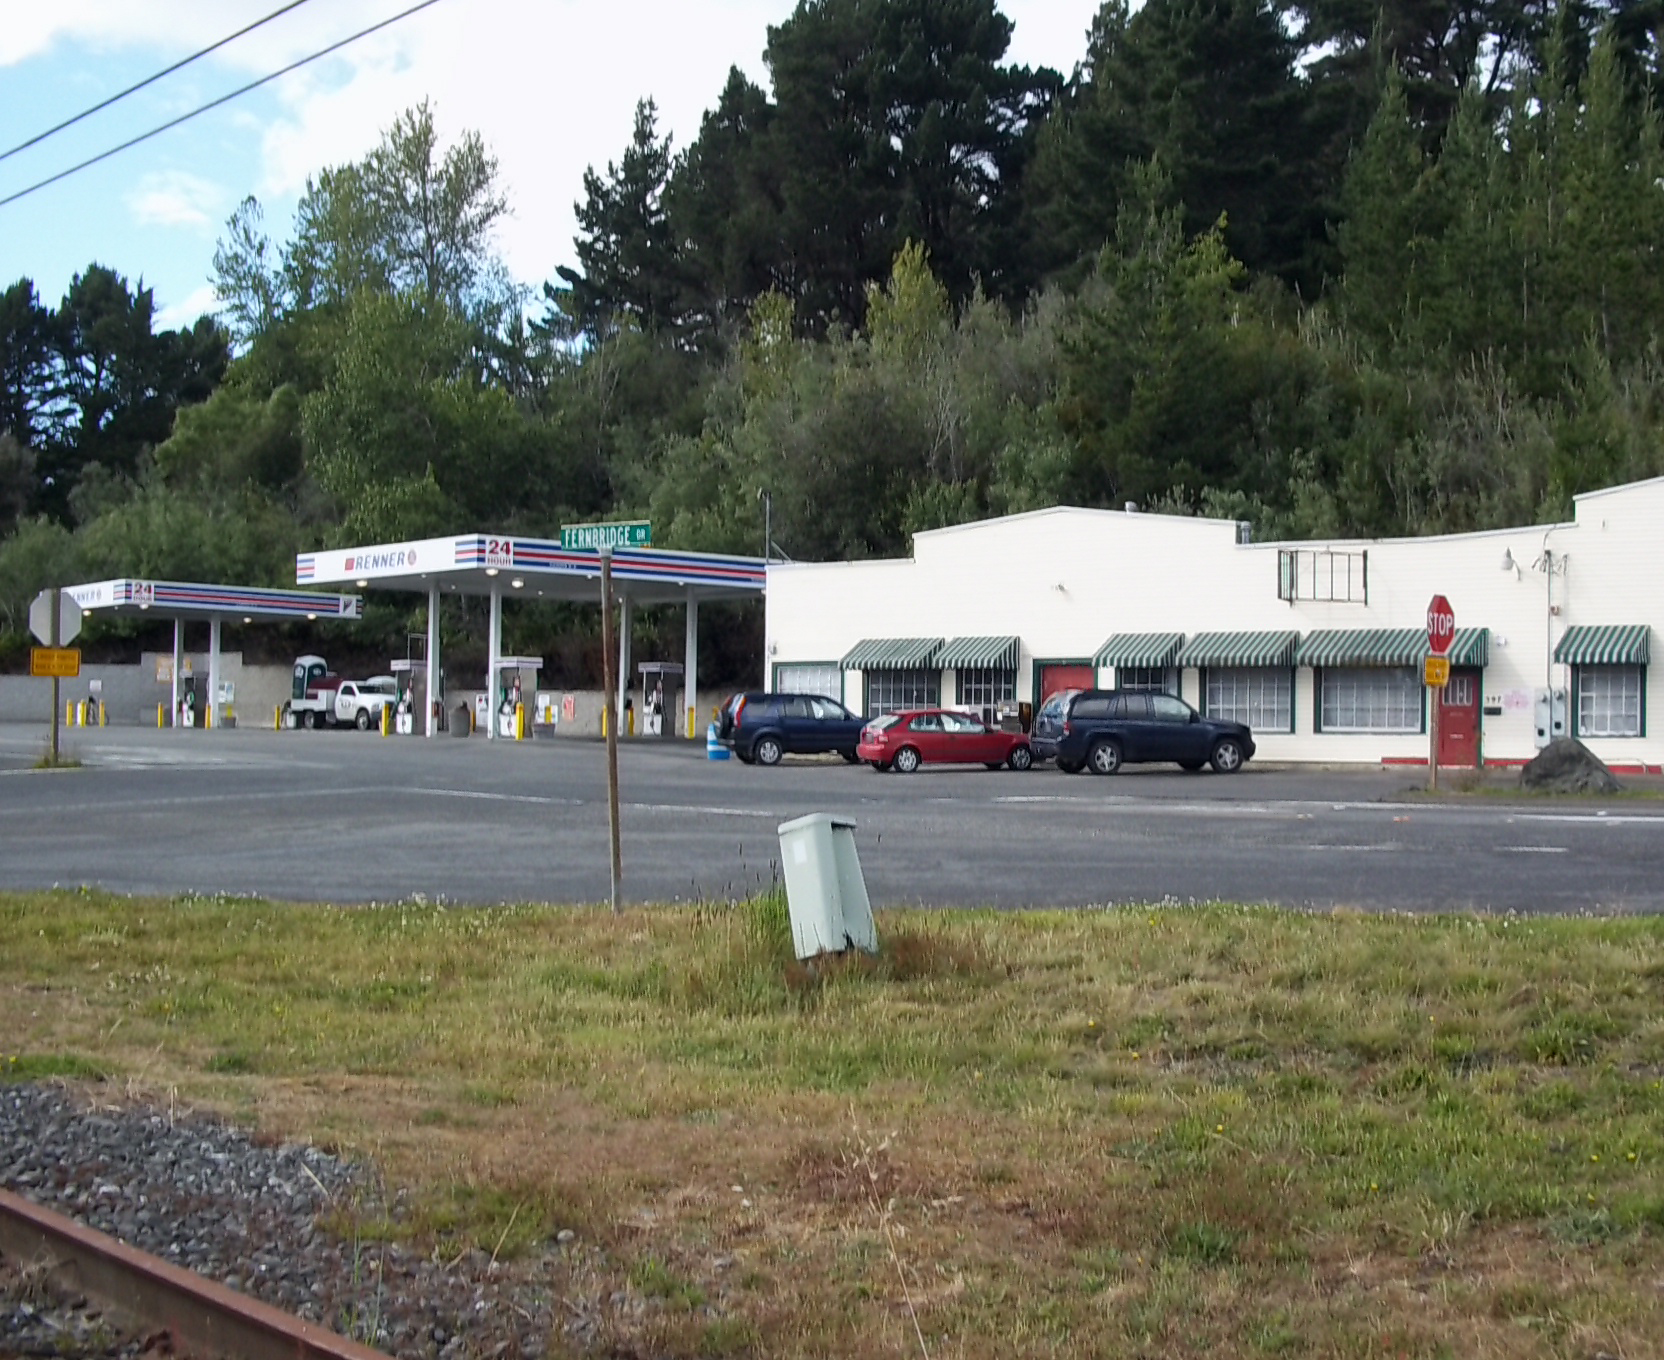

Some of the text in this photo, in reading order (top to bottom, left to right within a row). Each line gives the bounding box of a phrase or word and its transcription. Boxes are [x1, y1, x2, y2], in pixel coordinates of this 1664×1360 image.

[565, 526, 646, 548] FERNBRIDGE DR
[488, 539, 511, 555] 24
[355, 551, 406, 570] RENNER
[487, 556, 511, 566] HOUR
[134, 582, 152, 594] 24
[1427, 612, 1454, 636] STOP
